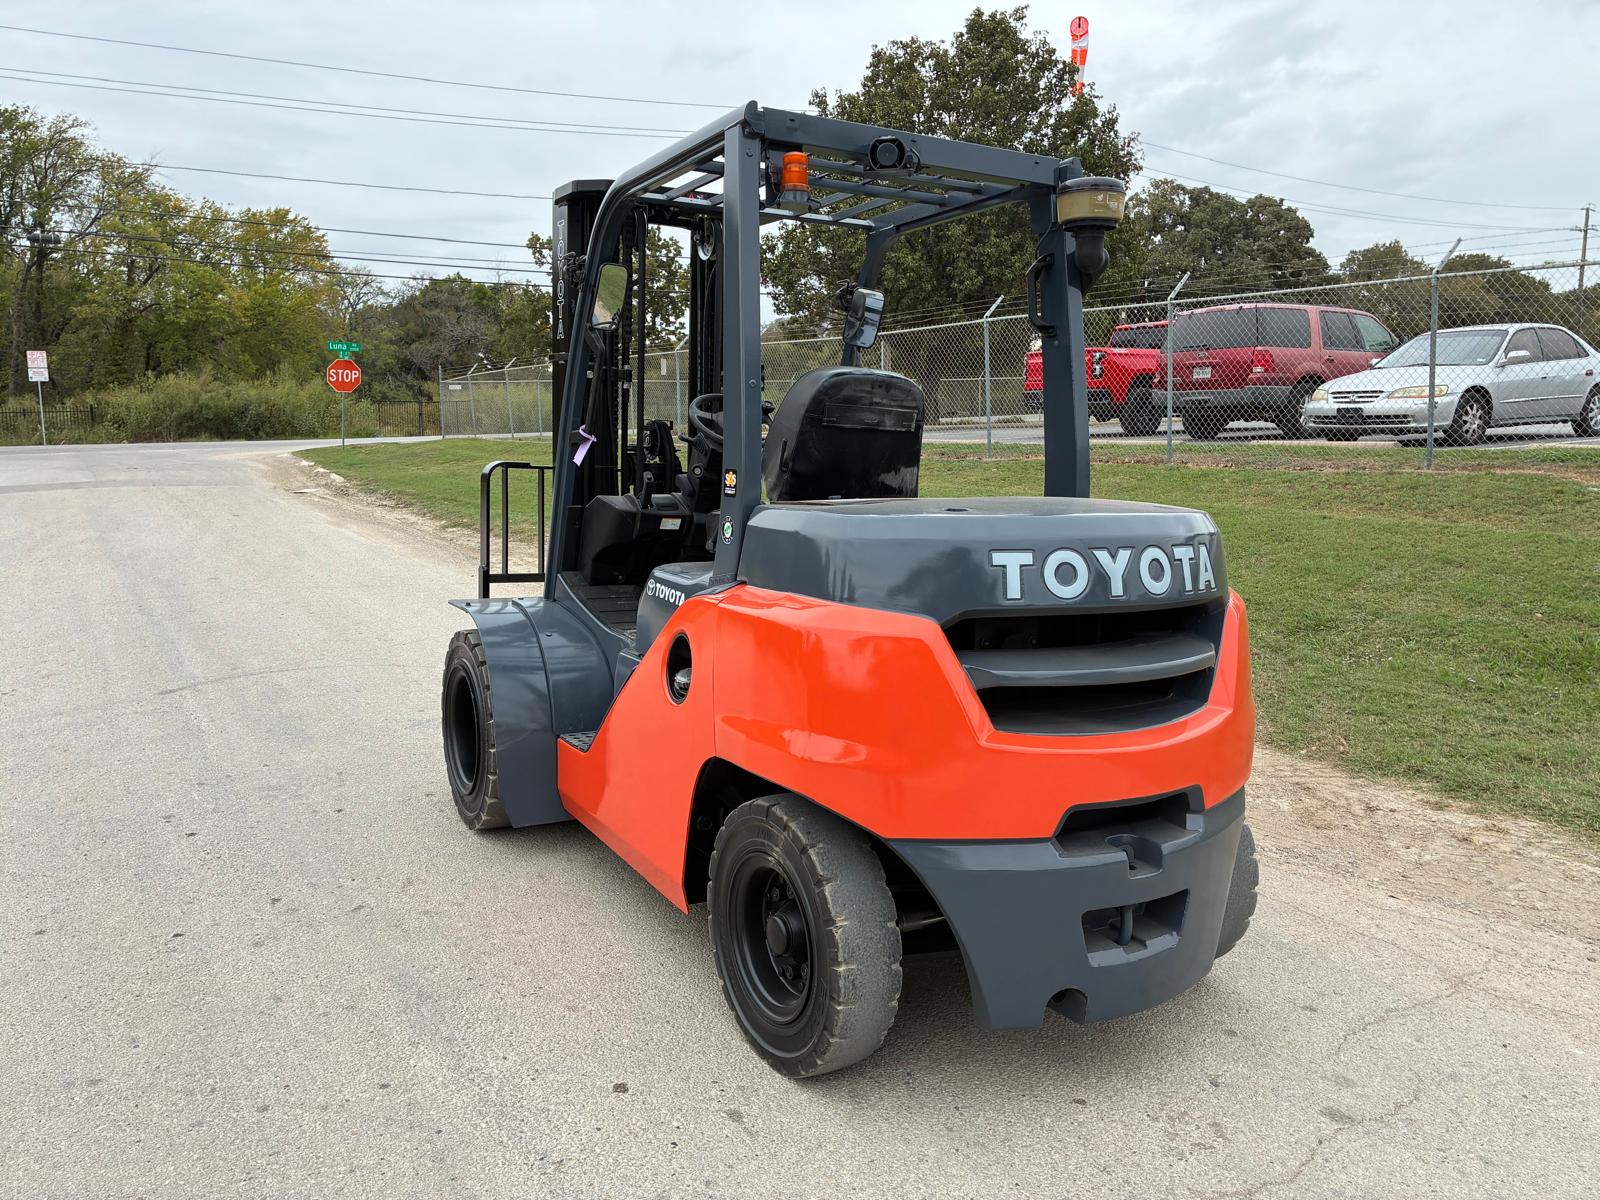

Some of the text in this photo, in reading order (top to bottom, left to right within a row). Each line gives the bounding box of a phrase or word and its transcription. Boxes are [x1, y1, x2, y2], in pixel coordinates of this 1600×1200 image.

[329, 342, 347, 350] Luna
[329, 369, 359, 382] STOP
[991, 544, 1217, 600] TOYOTA
[655, 583, 685, 606] TOYOTA
